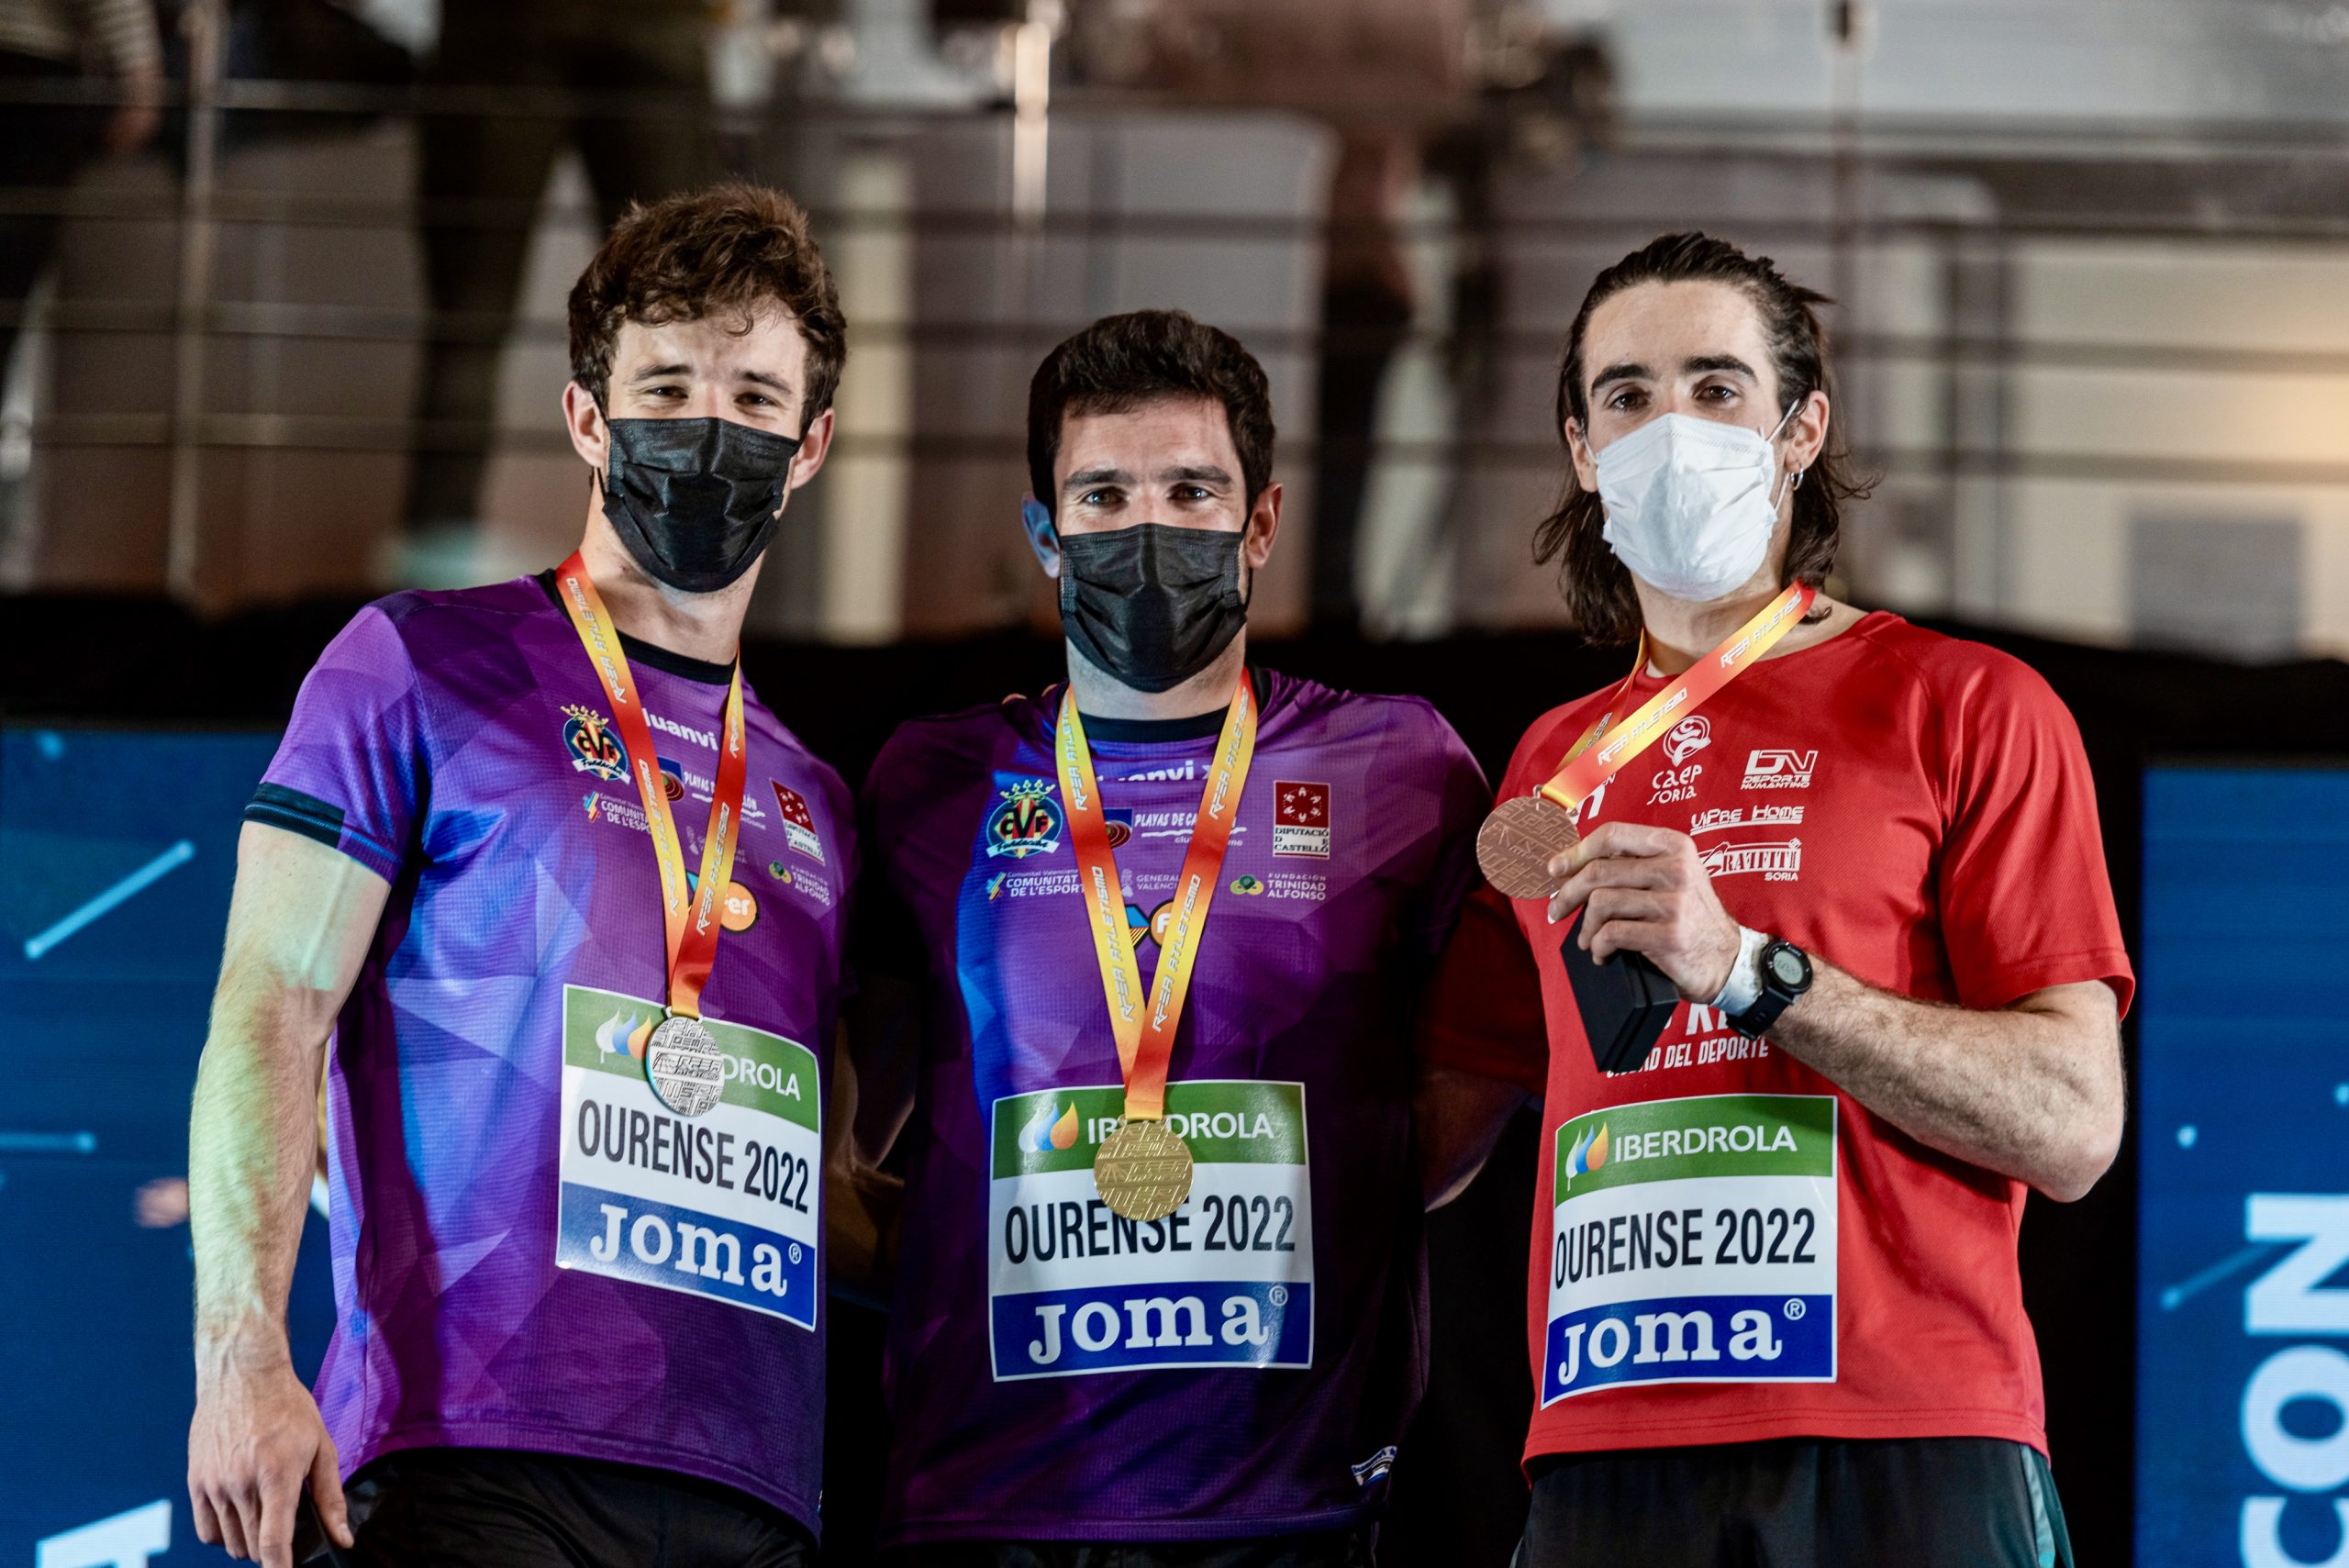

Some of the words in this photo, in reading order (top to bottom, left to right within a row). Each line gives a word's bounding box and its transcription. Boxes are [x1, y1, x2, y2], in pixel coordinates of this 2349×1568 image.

[1133, 812, 1170, 828] PLAYAS
[1171, 811, 1184, 827] DE
[1006, 874, 1079, 889] COMUNITAT
[1010, 887, 1027, 897] DE
[1136, 873, 1181, 883] GENERAL
[1267, 879, 1327, 892] TRINIDAD
[1764, 872, 1799, 882] SORIA
[1266, 889, 1327, 901] ALFONSO
[1091, 865, 1123, 962] ATLETISMO
[1152, 974, 1175, 1034] RFEA
[1167, 873, 1202, 973] ATLETISMO
[1113, 965, 1136, 1024] RFEA
[1664, 1042, 1693, 1069] DEL
[1697, 1035, 1769, 1065] DEPORTE
[578, 1098, 735, 1191] OURENSE
[743, 1140, 809, 1215] 2022
[1614, 1125, 1798, 1163] IBERDROLA
[1005, 1195, 1193, 1264] OURENSE
[1202, 1195, 1296, 1253] 2022
[1554, 1208, 1704, 1290] OURENSE
[1715, 1207, 1816, 1265] 2022
